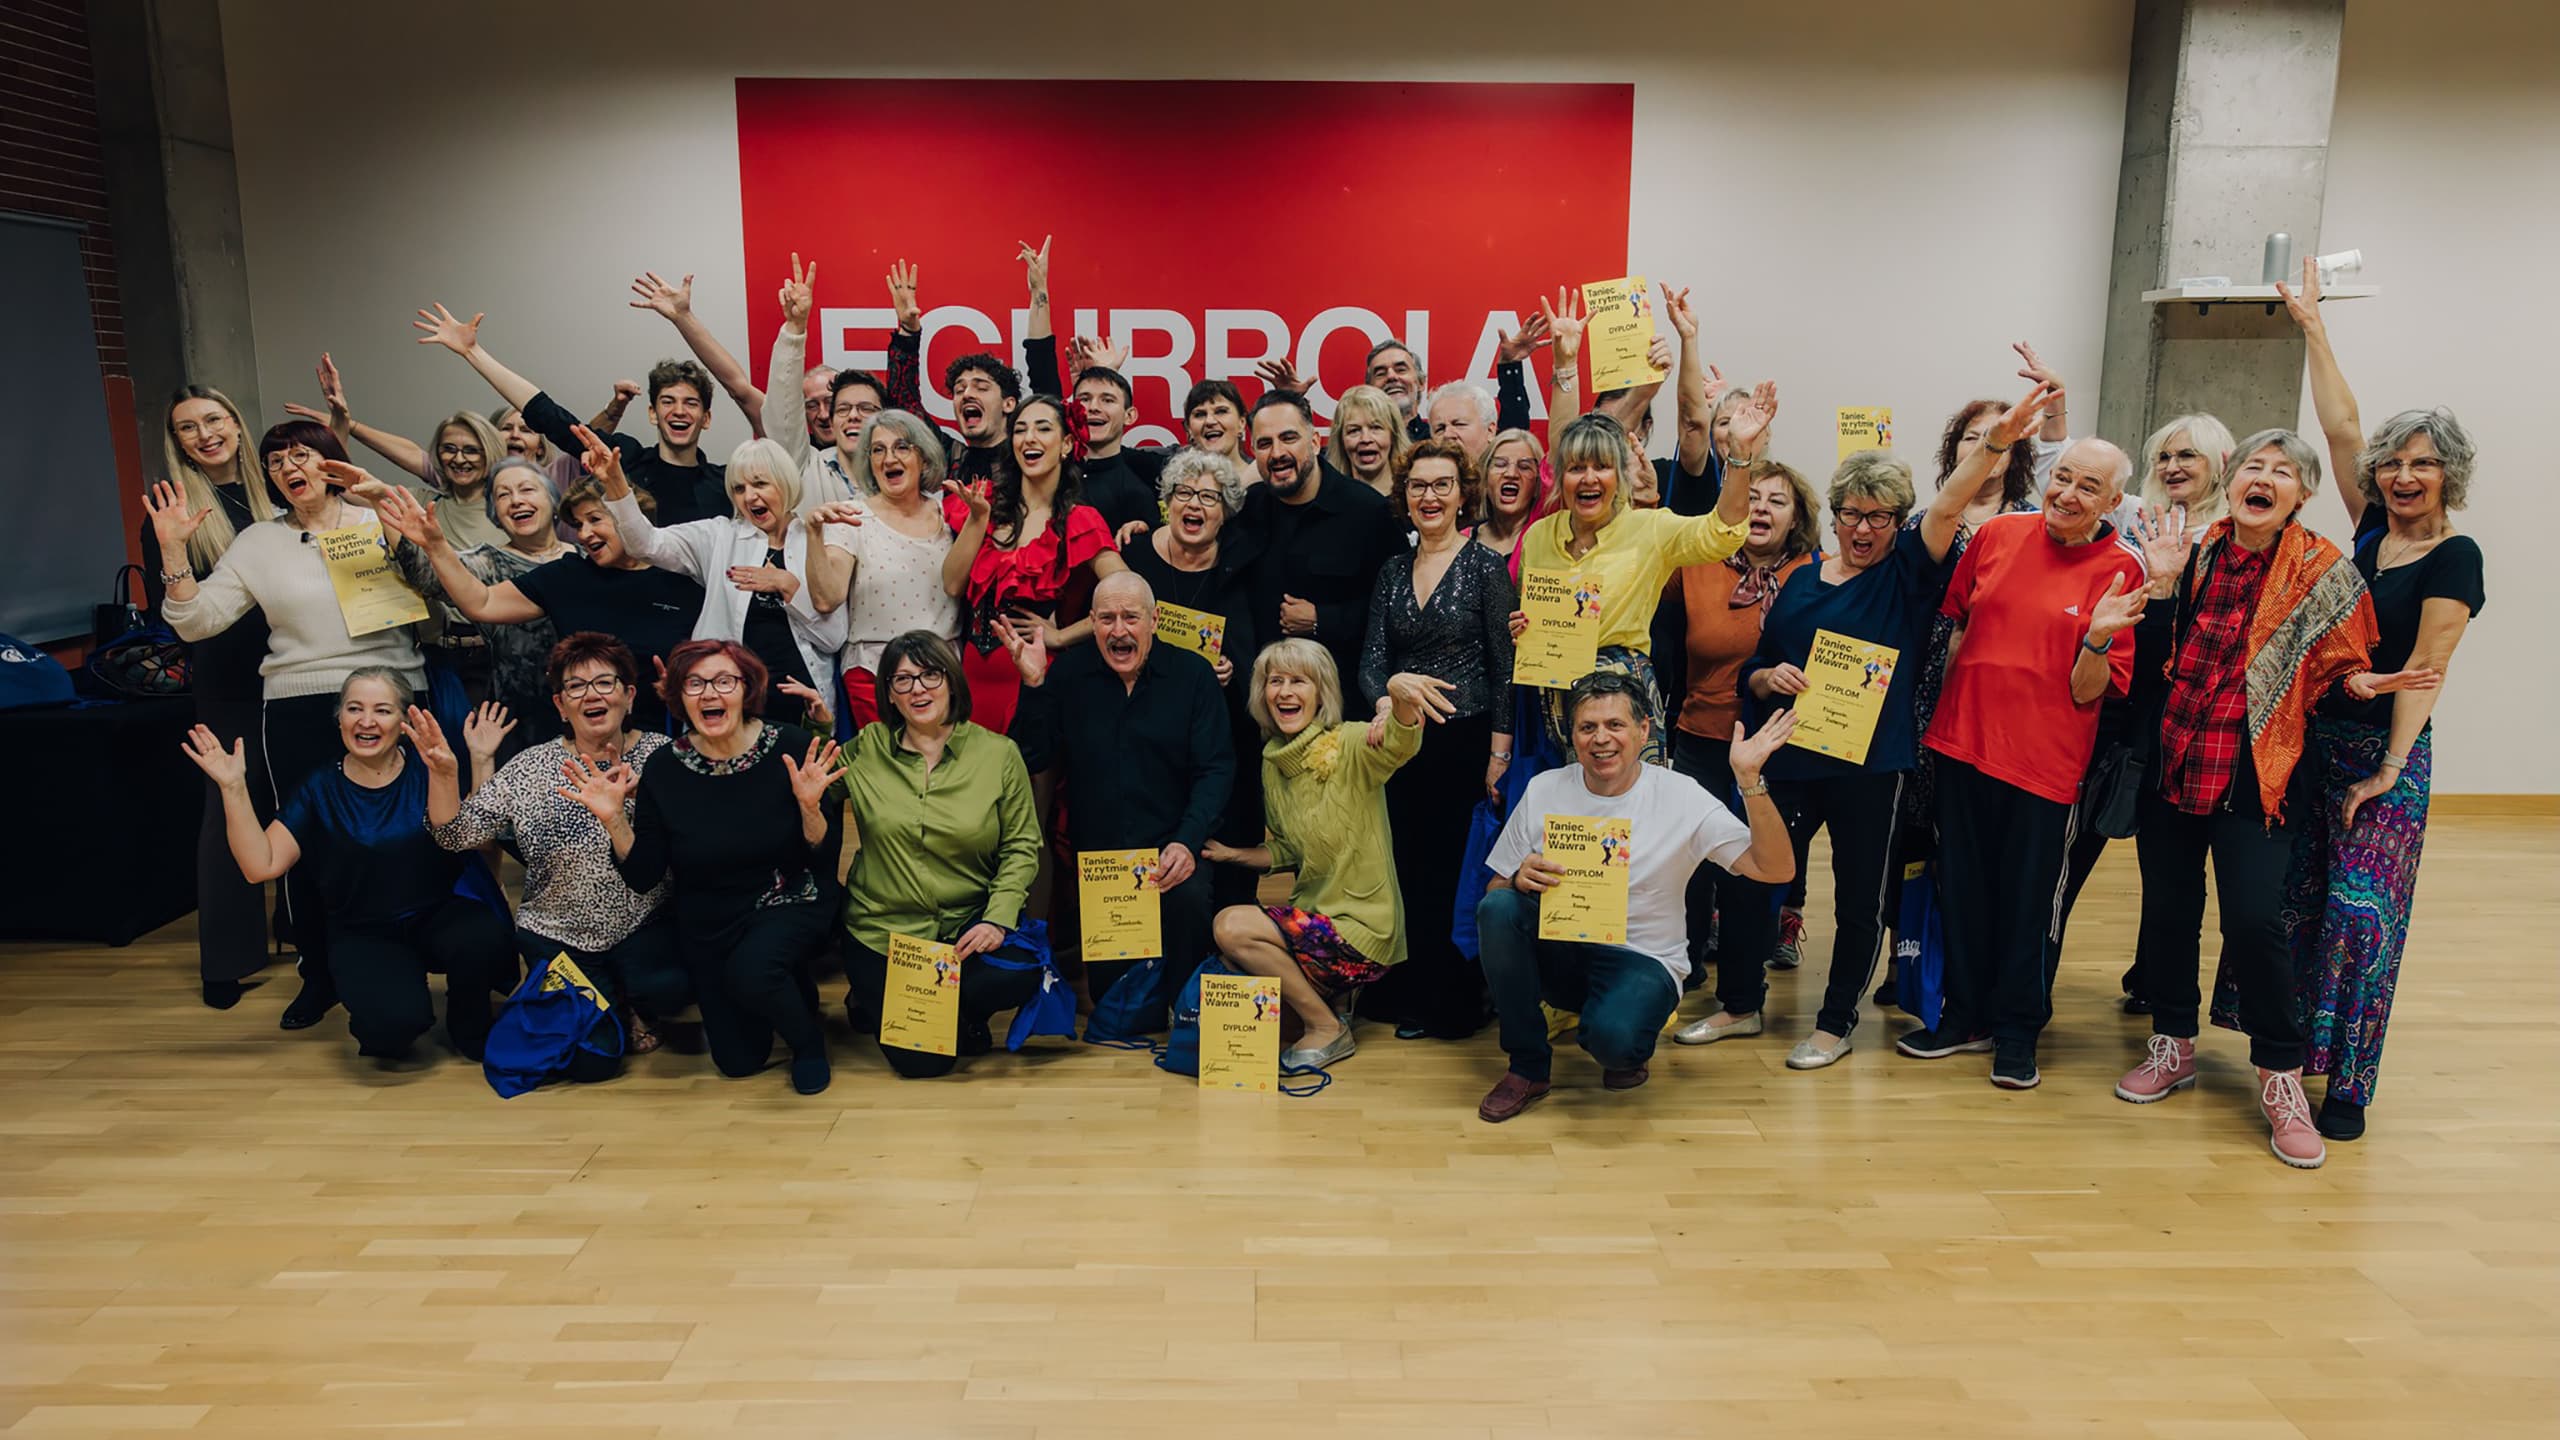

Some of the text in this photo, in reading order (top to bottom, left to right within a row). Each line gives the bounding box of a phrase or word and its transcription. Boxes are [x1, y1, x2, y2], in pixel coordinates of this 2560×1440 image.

[1587, 286, 1615, 298] Taniec
[1598, 294, 1627, 305] rytmie
[1608, 323, 1638, 334] DYPLOM
[1841, 412, 1865, 420] Taniec
[1850, 421, 1874, 429] rytmie
[324, 532, 358, 545] Taniec
[337, 538, 372, 552] rytmie
[328, 548, 365, 561] Wawra
[1528, 574, 1560, 585] Taniec
[1537, 585, 1571, 596] rytmie
[1526, 592, 1561, 603] Wawra
[1160, 607, 1188, 620] Taniec
[1158, 623, 1187, 636] Wawra
[1168, 618, 1197, 631] rytmie
[1542, 619, 1576, 629] DYPLOM
[1820, 636, 1853, 652] Taniec
[1816, 646, 1863, 665] w rytmie
[1814, 653, 1849, 670] Wawra
[1825, 684, 1860, 698] DYPLOM
[1549, 821, 1584, 832] Taniec
[1560, 832, 1598, 843] rytmie
[1548, 840, 1586, 851] Wawra
[1083, 857, 1116, 865] Taniec
[1095, 864, 1129, 874] rytmie
[1567, 869, 1603, 878] DYPLOM
[1083, 873, 1119, 882] Wawra
[1103, 895, 1137, 903] DYPLOM
[894, 939, 922, 953] Taniec
[902, 951, 933, 965] rytmie
[892, 957, 922, 971] Wawra
[557, 960, 578, 983] Taniec
[905, 984, 937, 996] DYPLOM
[1205, 980, 1238, 990] Taniec
[1216, 990, 1250, 1000] rytmie
[1205, 998, 1240, 1008] Wawra
[1222, 1024, 1257, 1032] DYPLOM
